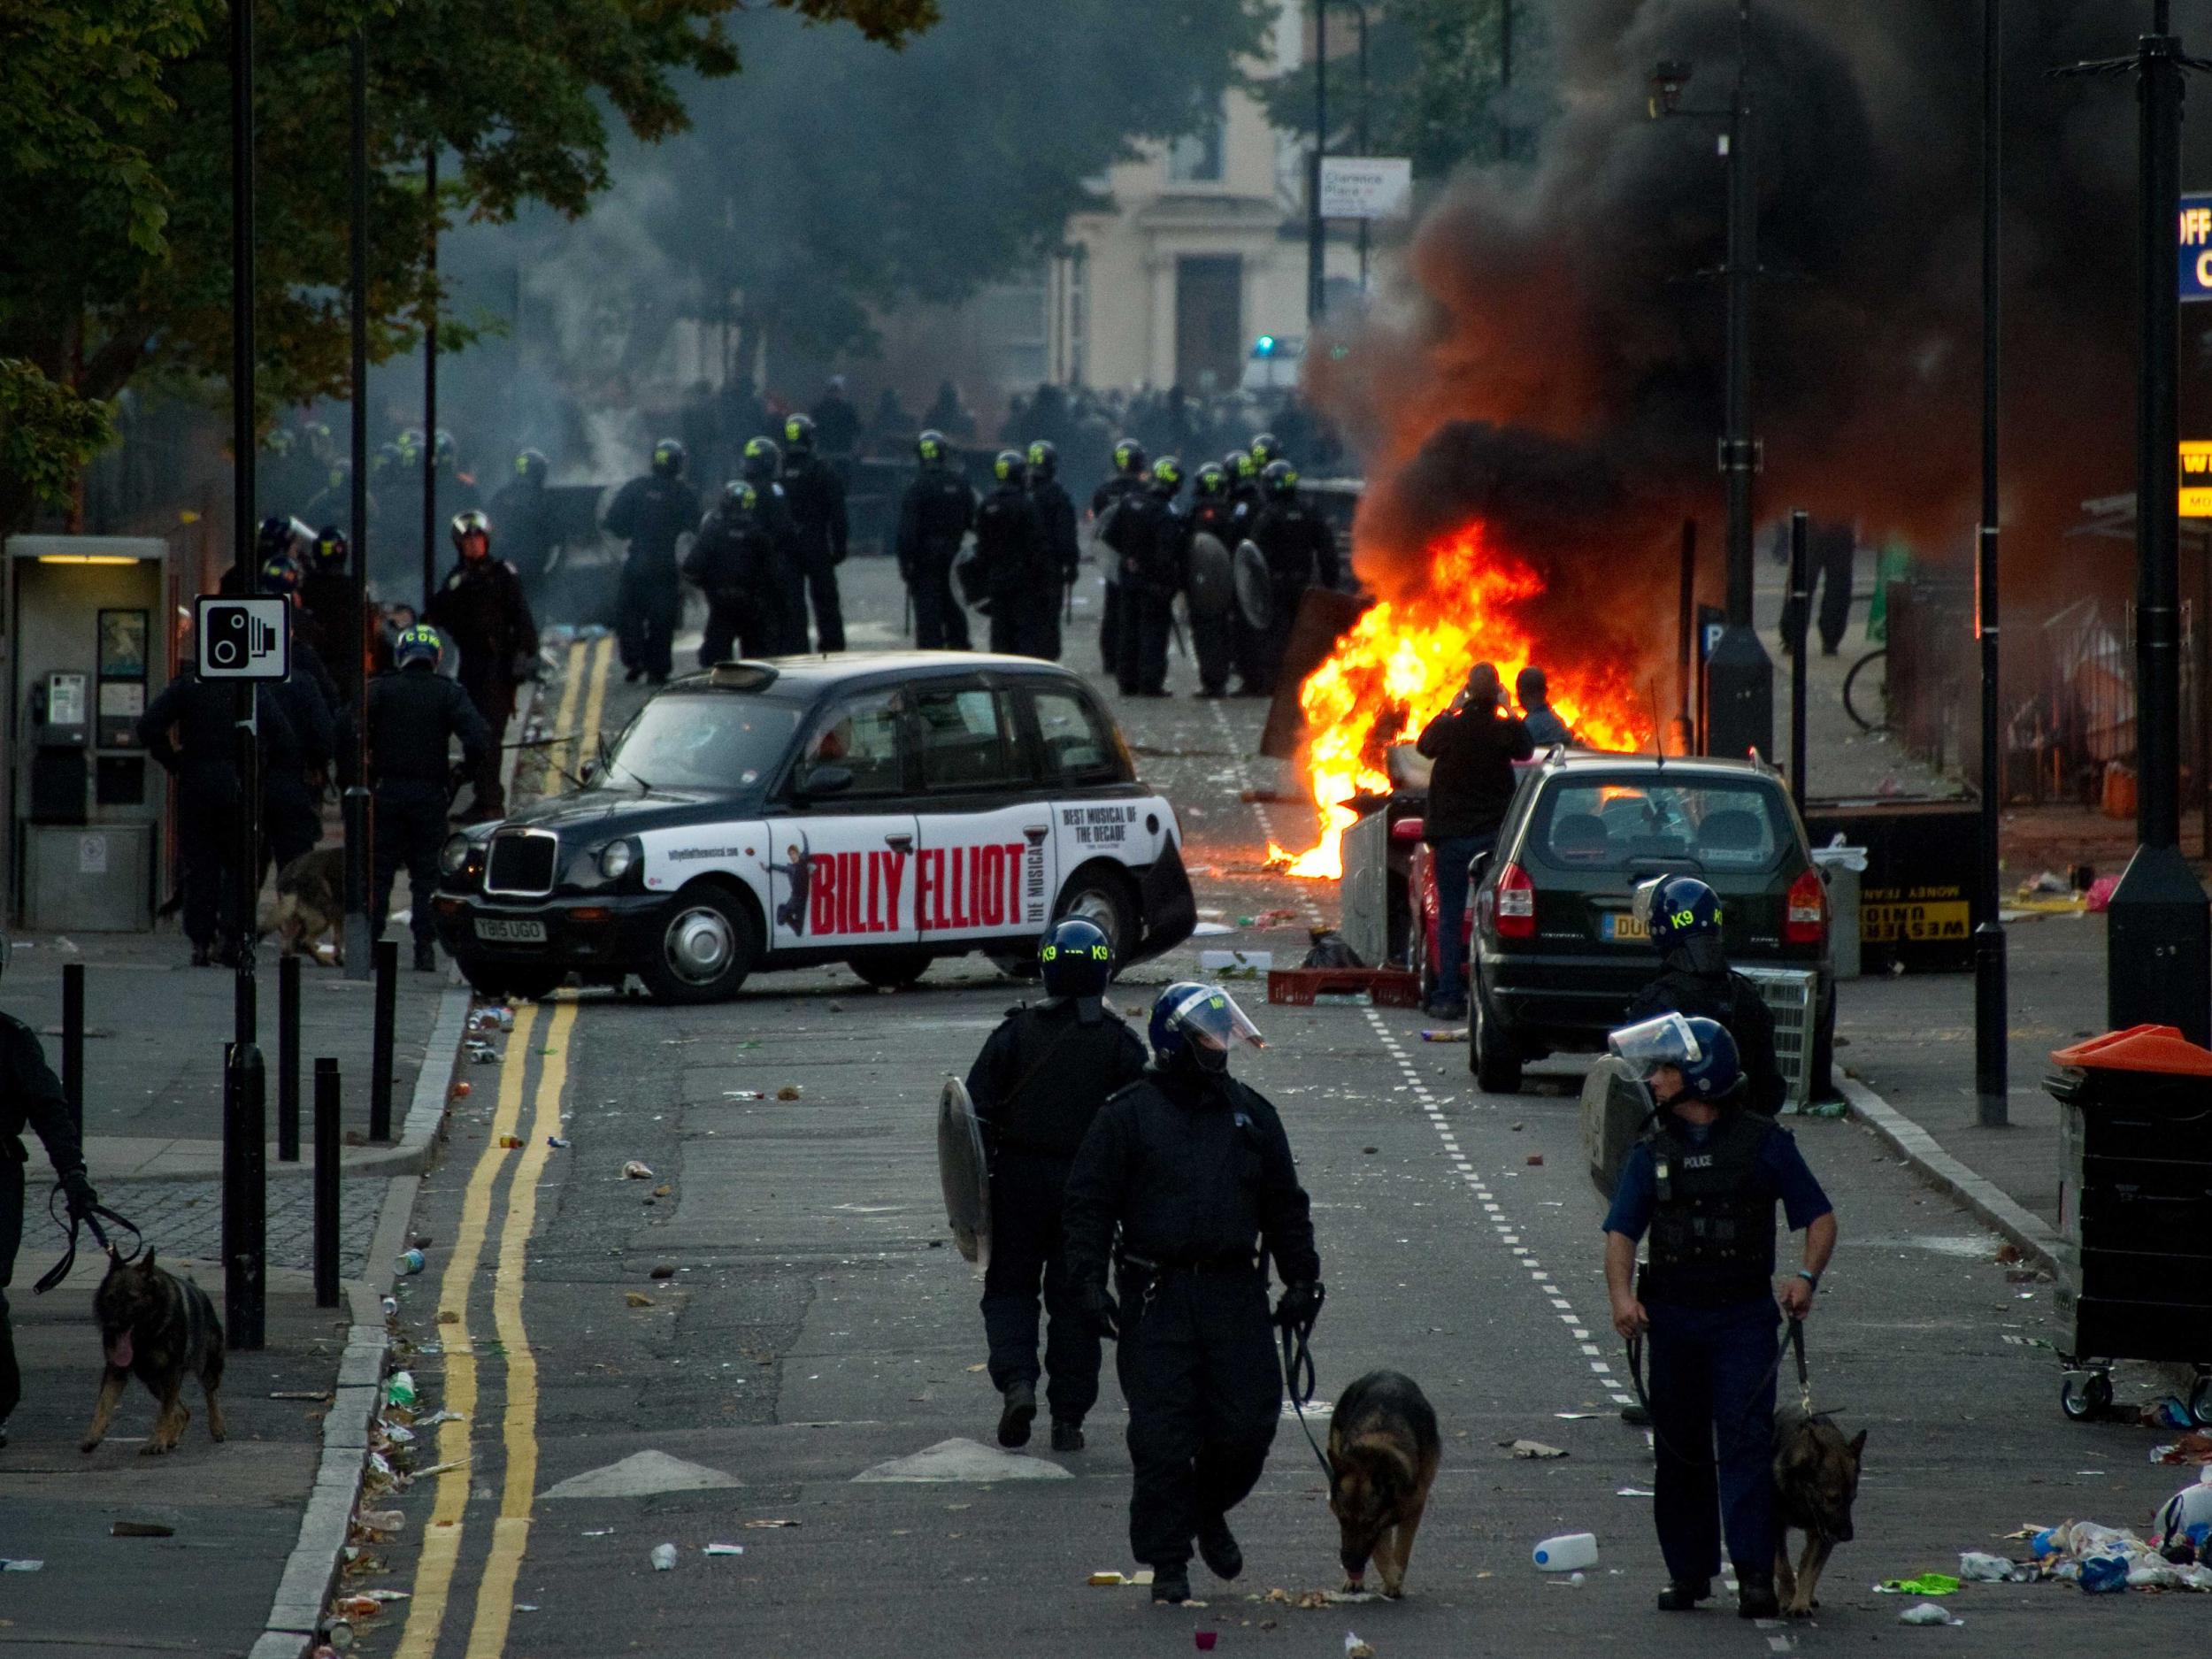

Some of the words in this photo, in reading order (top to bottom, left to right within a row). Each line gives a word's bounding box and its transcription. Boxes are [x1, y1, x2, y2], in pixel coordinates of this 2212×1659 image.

[1707, 624, 1724, 651] P
[1063, 808, 1085, 826] BEST
[1087, 807, 1125, 825] MUSICAL
[1126, 806, 1137, 823] OF
[1075, 826, 1092, 843] THE
[1094, 825, 1126, 841] DECADE
[809, 850, 906, 936] BILLY
[914, 842, 1025, 931] ELLIOT
[1028, 902, 1044, 924] THE
[1671, 910, 1694, 929] K9
[1042, 945, 1057, 963] K9
[1092, 944, 1108, 961] K9
[1684, 1156, 1714, 1169] POLICE
